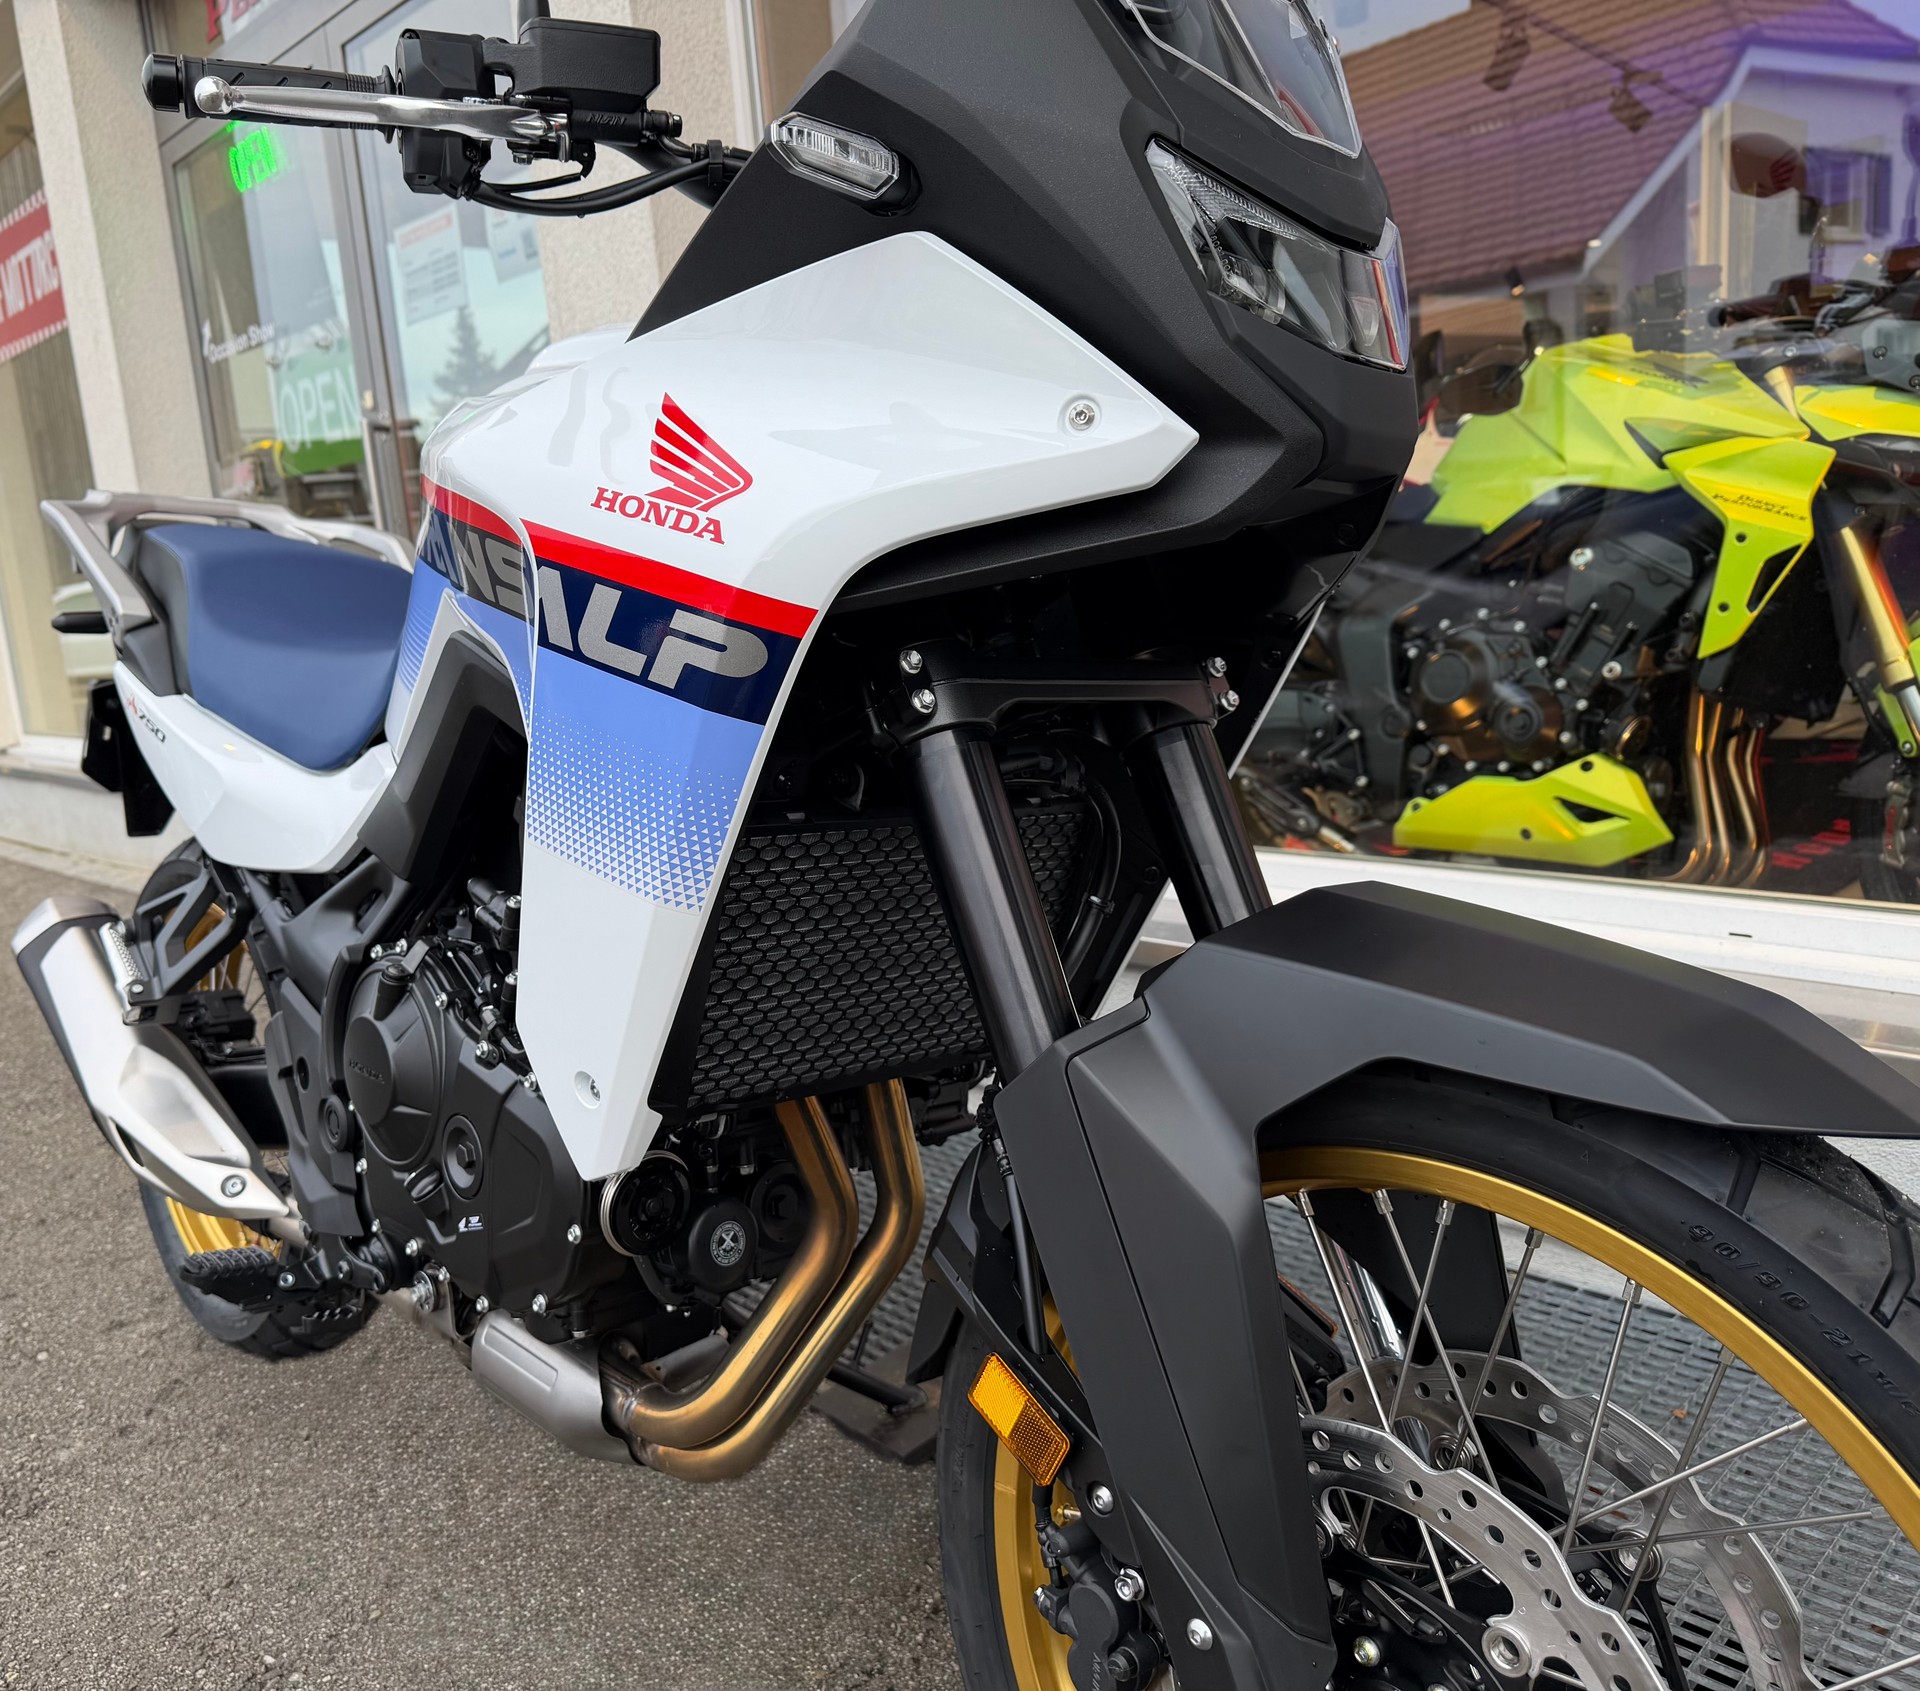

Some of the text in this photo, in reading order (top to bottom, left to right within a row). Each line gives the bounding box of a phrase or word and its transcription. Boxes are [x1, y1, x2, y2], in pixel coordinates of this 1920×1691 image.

[228, 126, 277, 192] OPEN
[280, 364, 362, 453] OPEN
[590, 486, 725, 545] HONDA
